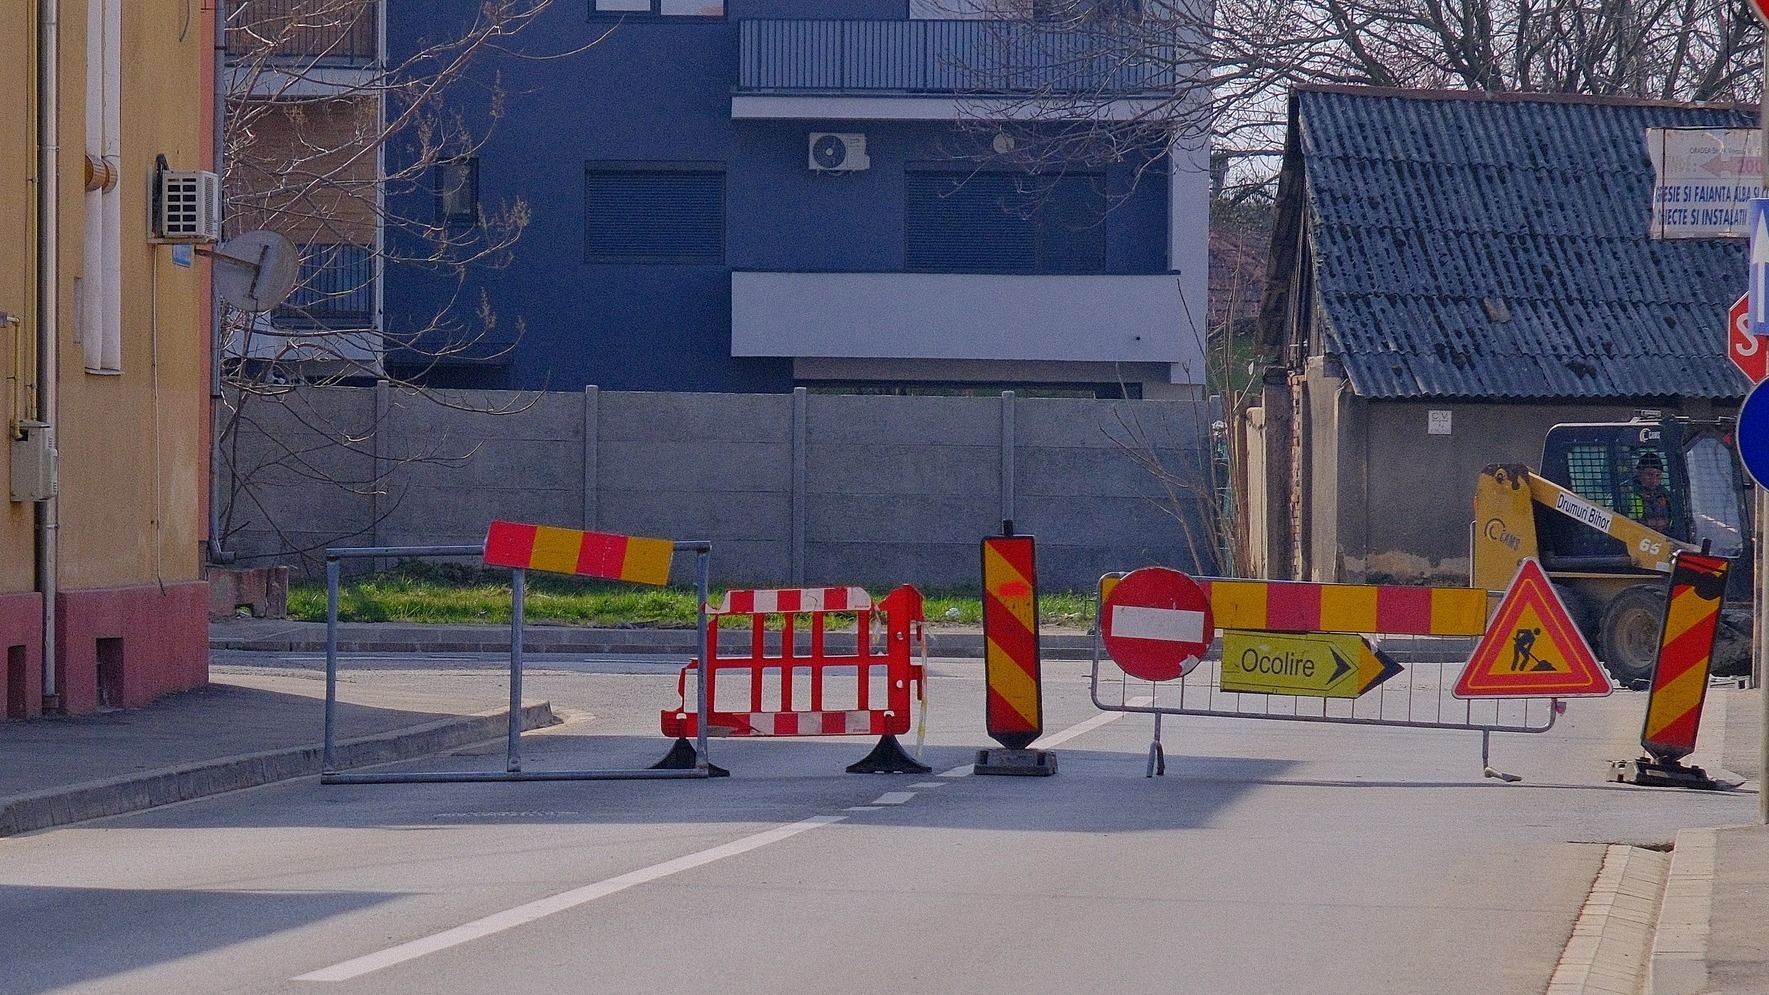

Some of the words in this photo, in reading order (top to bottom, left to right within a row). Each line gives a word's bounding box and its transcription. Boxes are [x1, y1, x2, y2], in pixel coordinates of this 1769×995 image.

[1683, 185, 1692, 202] SI
[1695, 185, 1731, 202] FAIANTA
[1691, 208, 1700, 226] SI
[1557, 494, 1590, 521] Drumuri
[1588, 508, 1610, 530] Bihor
[1241, 648, 1315, 677] Ocolire
